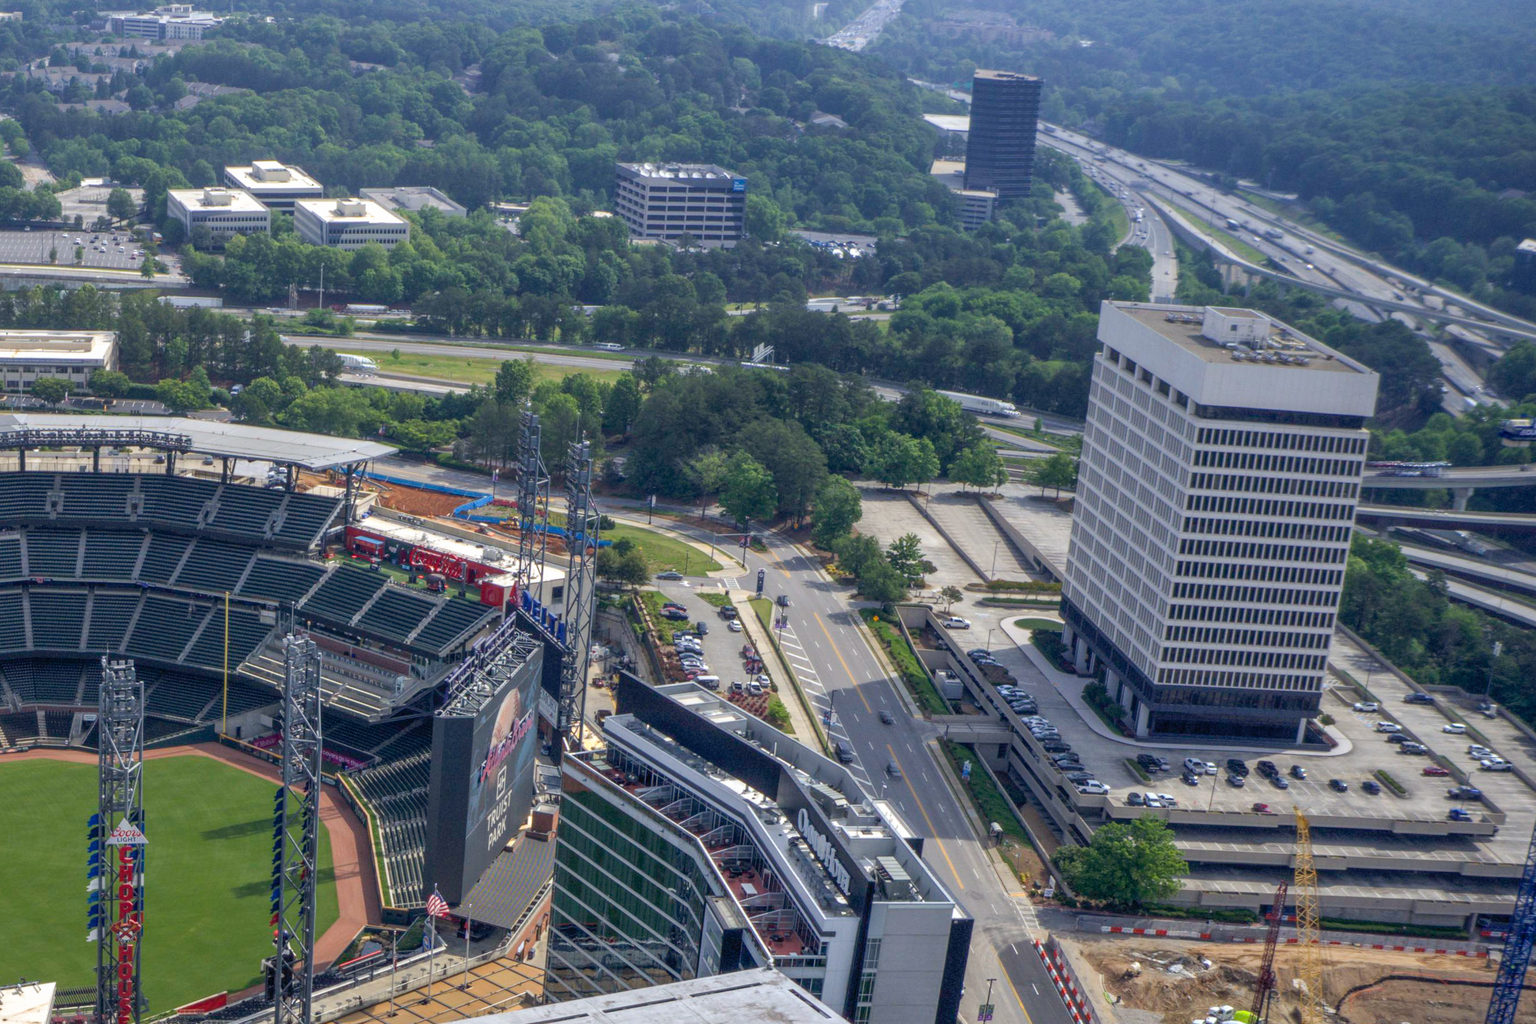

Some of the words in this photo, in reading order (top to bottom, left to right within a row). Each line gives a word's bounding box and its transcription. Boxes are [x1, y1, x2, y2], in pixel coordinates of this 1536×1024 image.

[487, 789, 512, 829] TRUIST
[111, 826, 141, 838] Coors
[487, 815, 507, 851] PARK
[119, 846, 133, 919] CHOP
